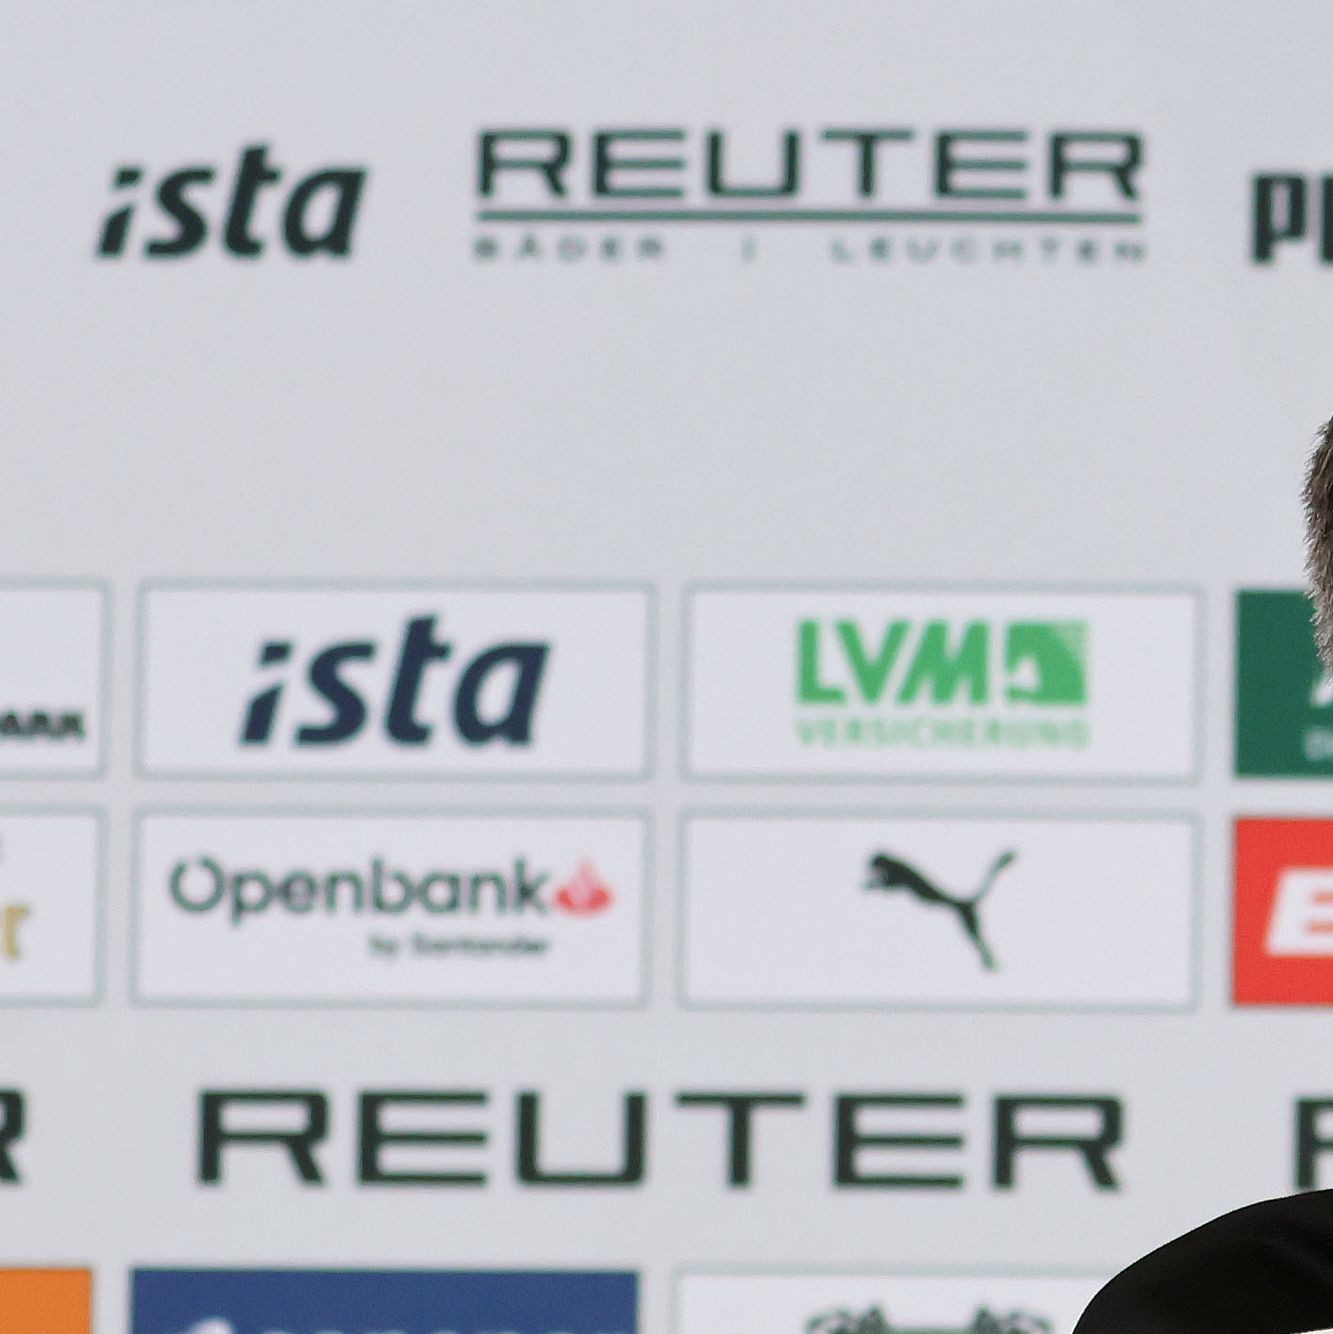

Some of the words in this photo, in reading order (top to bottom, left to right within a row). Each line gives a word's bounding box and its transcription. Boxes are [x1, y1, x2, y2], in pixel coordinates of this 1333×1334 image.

[94, 138, 369, 259] ista
[476, 127, 1146, 202] REUTER
[473, 229, 668, 264] BÄDER
[830, 236, 1148, 265] LEUCHTEN
[239, 613, 552, 748] ista
[795, 619, 990, 709] LVM
[170, 854, 554, 930] Openbank
[196, 1088, 1128, 1193] REUTER
